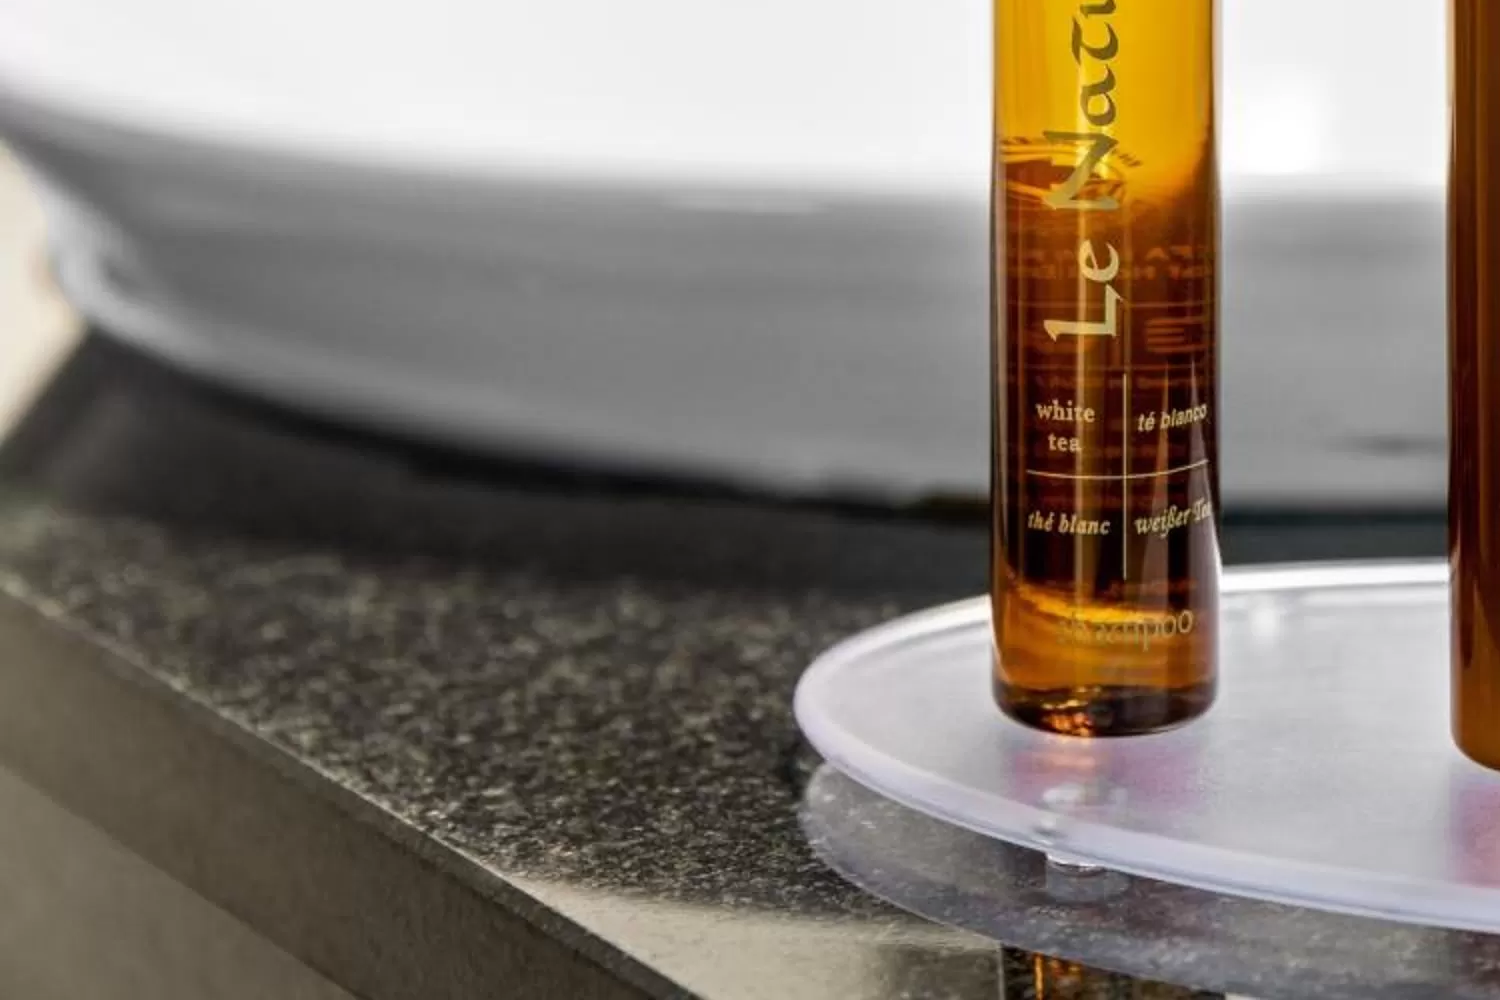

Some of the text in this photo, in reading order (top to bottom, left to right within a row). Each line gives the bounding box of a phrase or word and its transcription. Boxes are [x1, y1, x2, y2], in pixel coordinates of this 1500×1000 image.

[1043, 238, 1123, 342] Le
[1035, 400, 1096, 422] white
[1138, 403, 1207, 432] té blanco
[1048, 431, 1082, 452] tea
[1027, 511, 1111, 535] thé blanc
